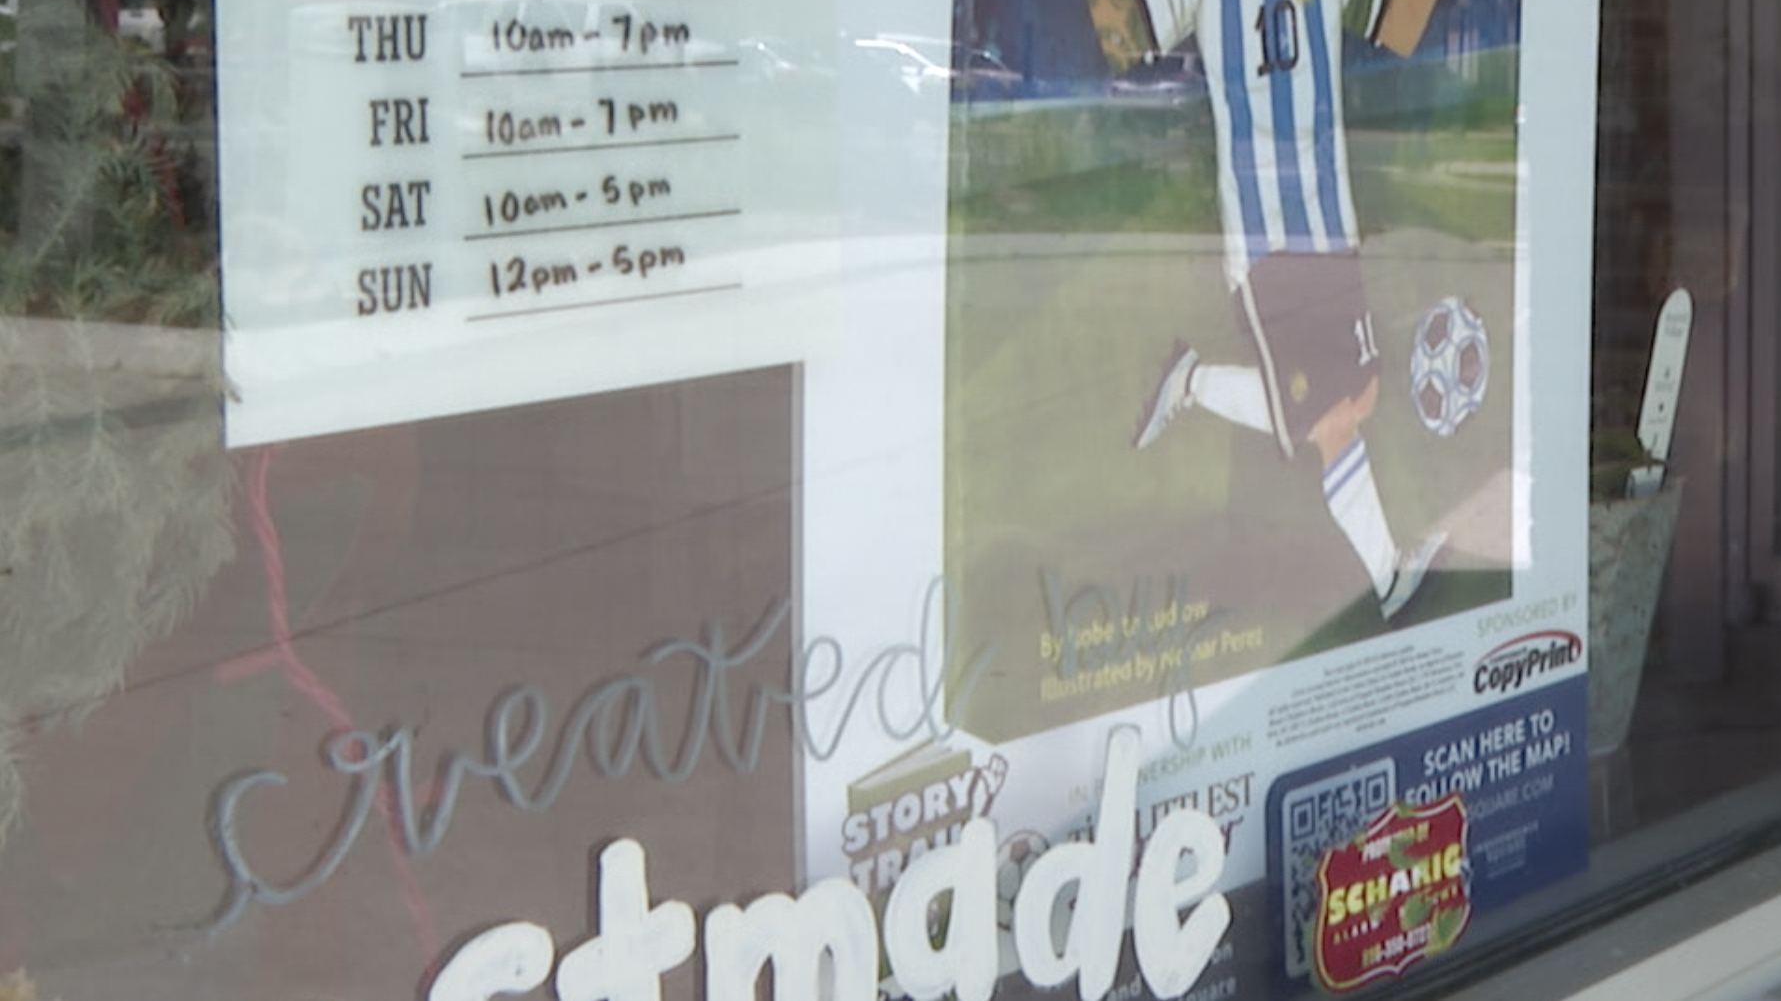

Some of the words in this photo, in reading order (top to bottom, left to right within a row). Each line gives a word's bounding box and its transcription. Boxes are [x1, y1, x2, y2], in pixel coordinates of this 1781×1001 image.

[348, 14, 428, 63] THU
[1254, 0, 1299, 78] 10
[369, 98, 431, 147] FRI
[361, 180, 432, 232] SAT
[357, 263, 433, 317] SUN
[1477, 596, 1560, 638] SPONSORED
[1040, 632, 1063, 664] By
[1474, 637, 1576, 695] CopyPrint
[1041, 659, 1131, 702] Illustrated
[1134, 651, 1156, 683] by
[205, 573, 985, 941] created
[1405, 762, 1484, 806] FOLLOW
[1487, 750, 1523, 783] THE
[1525, 730, 1571, 770] MAP!
[1424, 735, 1476, 777] SCAN
[1479, 717, 1526, 757] HERE
[1530, 709, 1555, 737] TO
[841, 768, 975, 857] STORY
